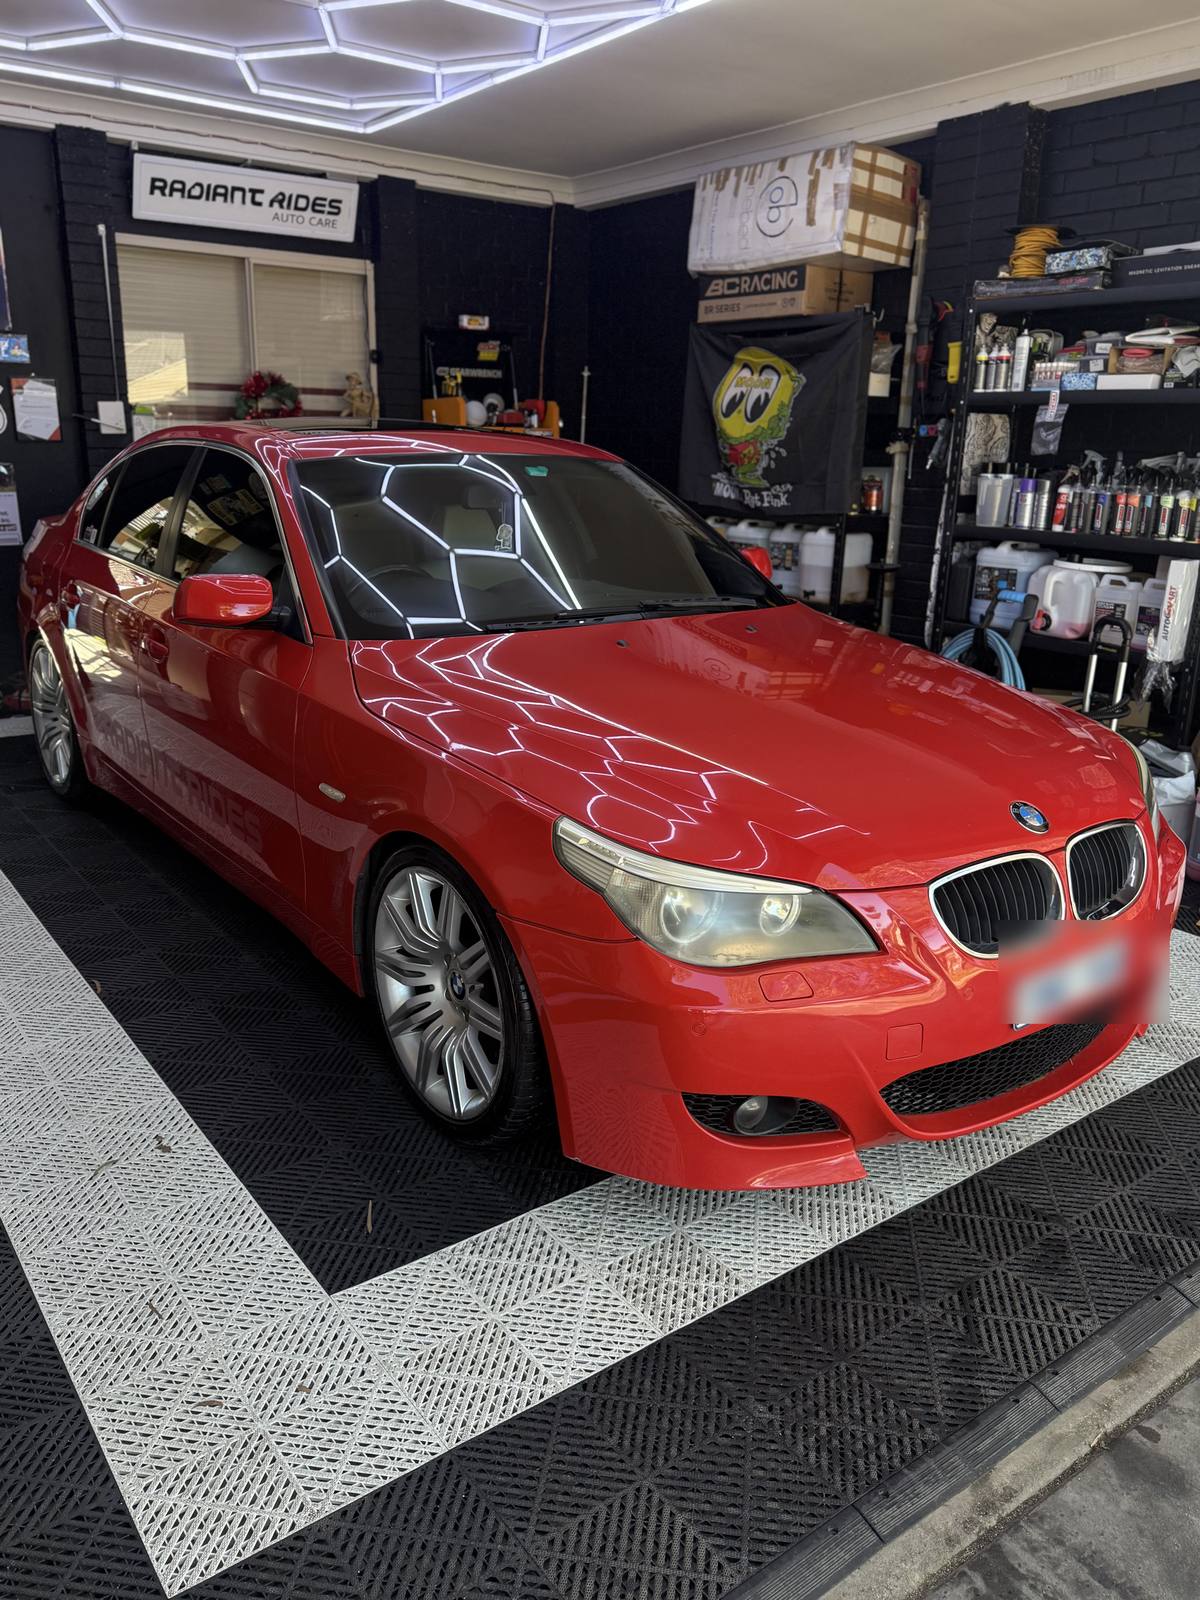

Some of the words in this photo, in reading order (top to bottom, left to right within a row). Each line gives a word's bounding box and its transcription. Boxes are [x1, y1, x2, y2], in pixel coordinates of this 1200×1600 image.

[149, 177, 265, 206] RADIANT
[268, 191, 343, 216] RIDES
[272, 212, 305, 225] AUTO
[308, 216, 338, 229] CARE
[715, 303, 741, 313] SERIES
